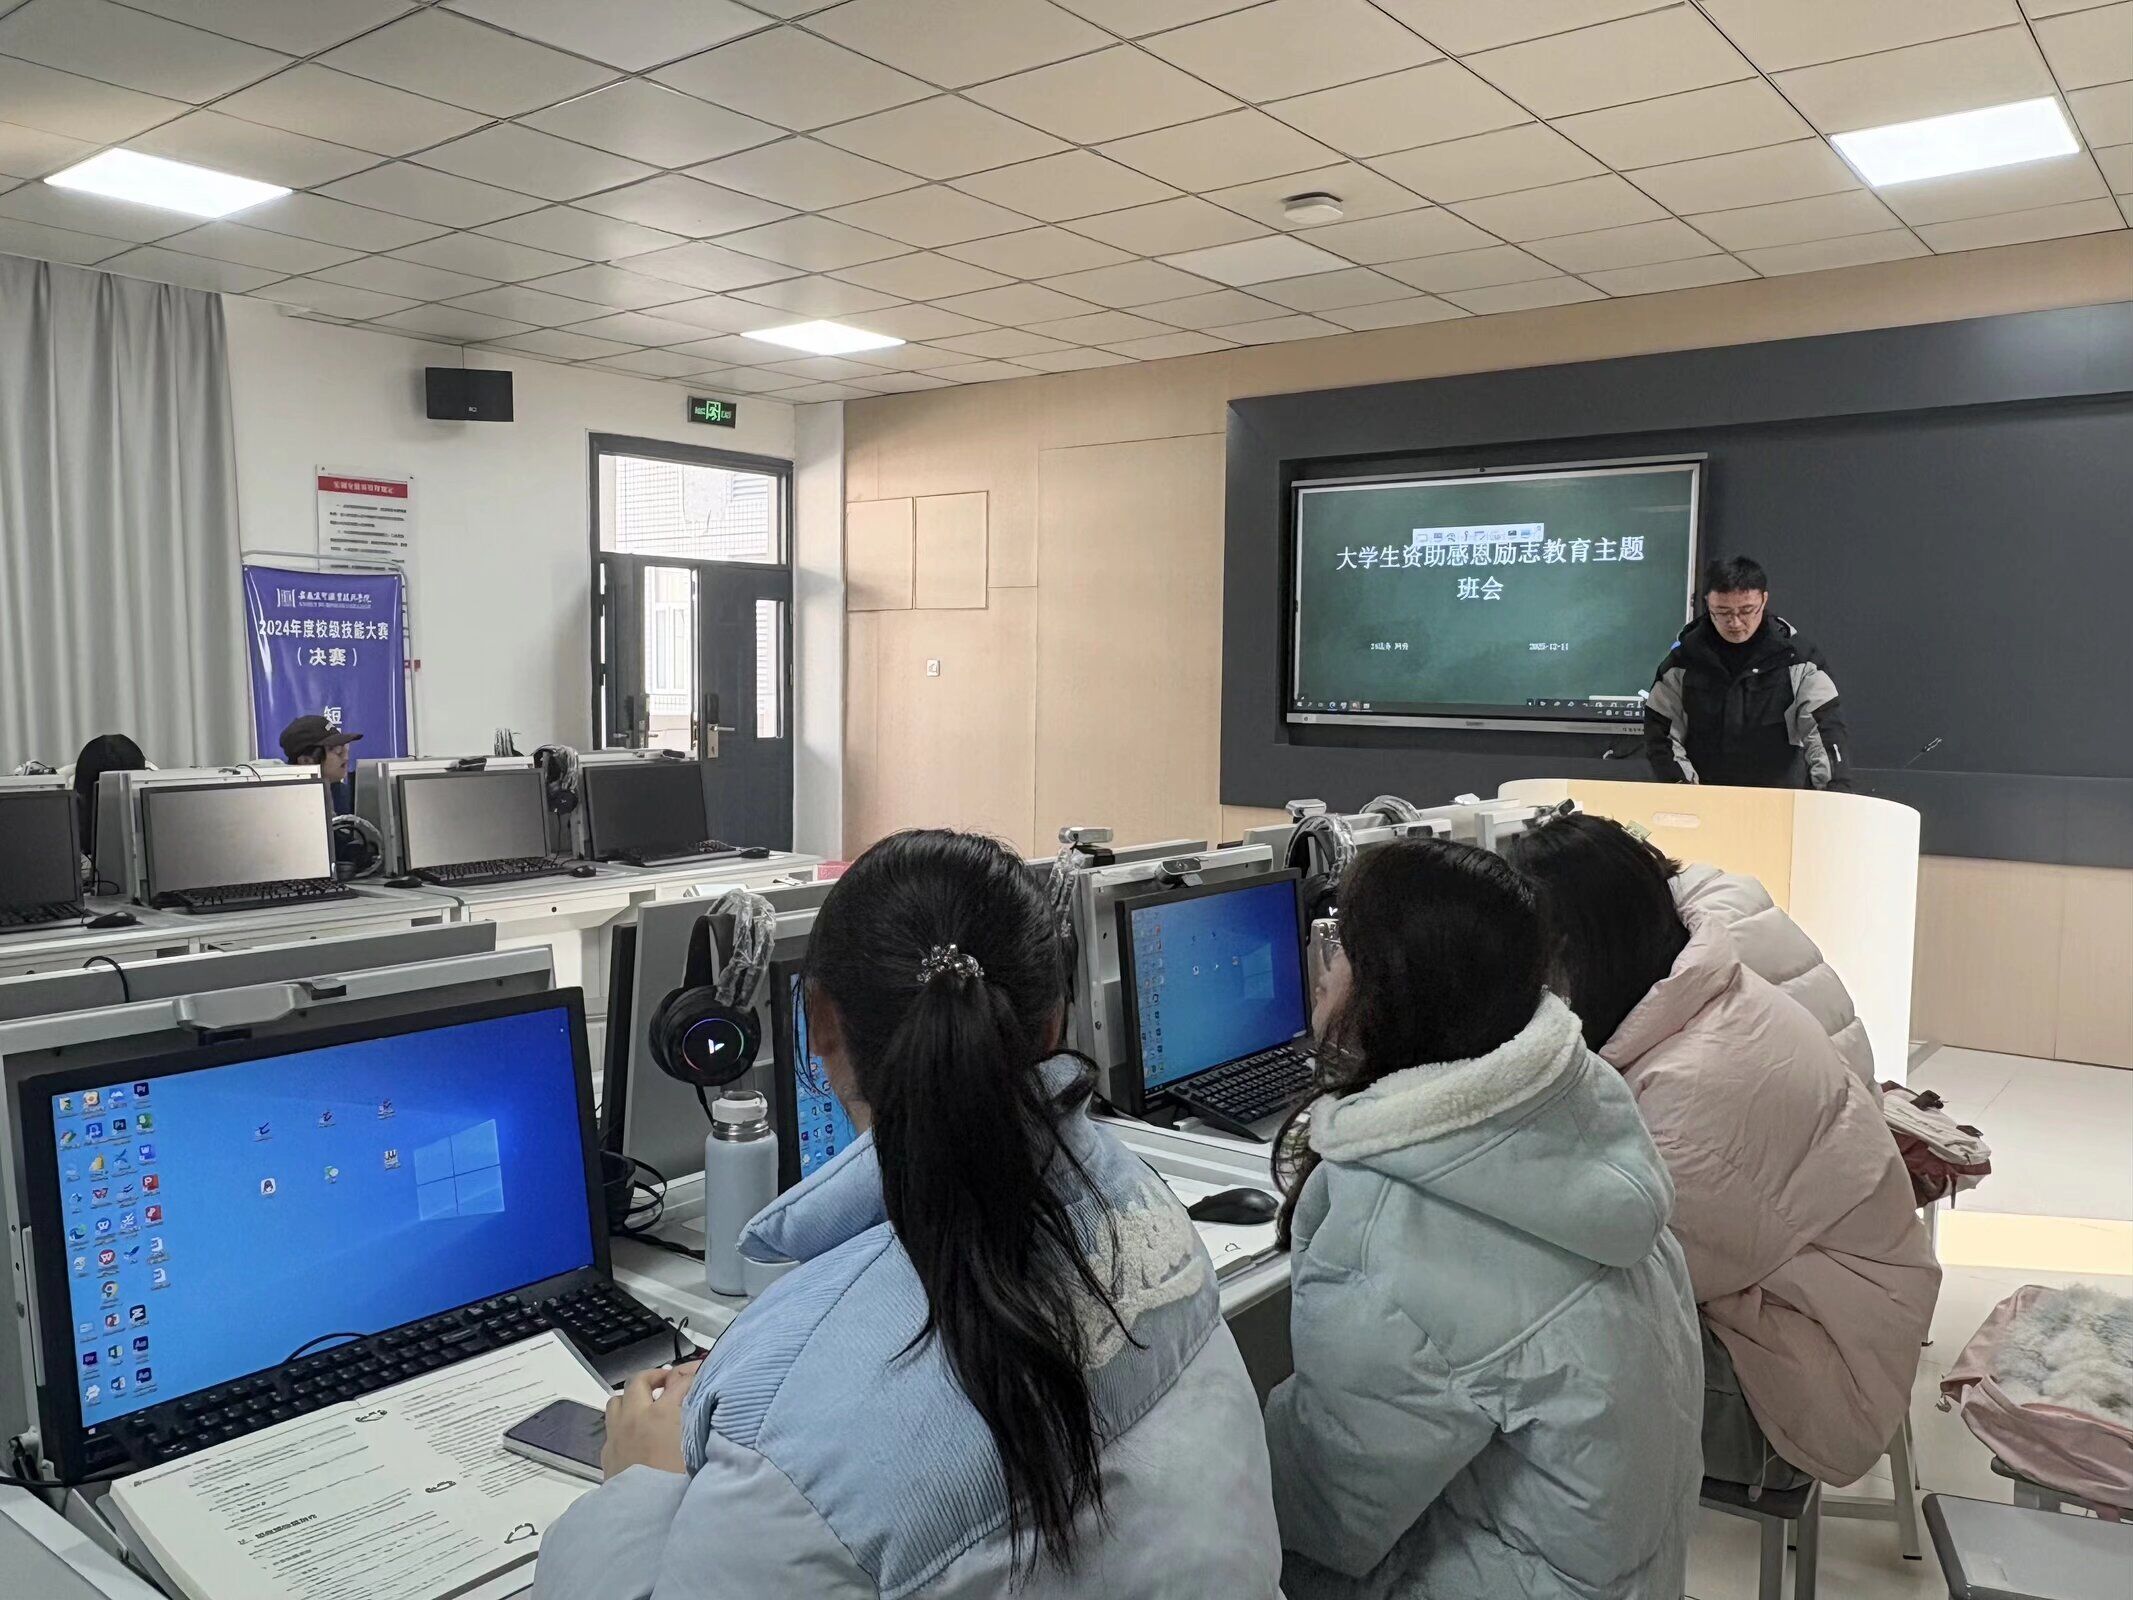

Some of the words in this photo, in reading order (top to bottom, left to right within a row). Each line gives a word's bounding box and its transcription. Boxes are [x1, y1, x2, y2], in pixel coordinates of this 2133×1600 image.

[1336, 535, 1645, 571] 大学生资助感恩励志教育主题
[1456, 575, 1504, 600] 班会
[259, 619, 389, 640] 2024年度校级技能大赛
